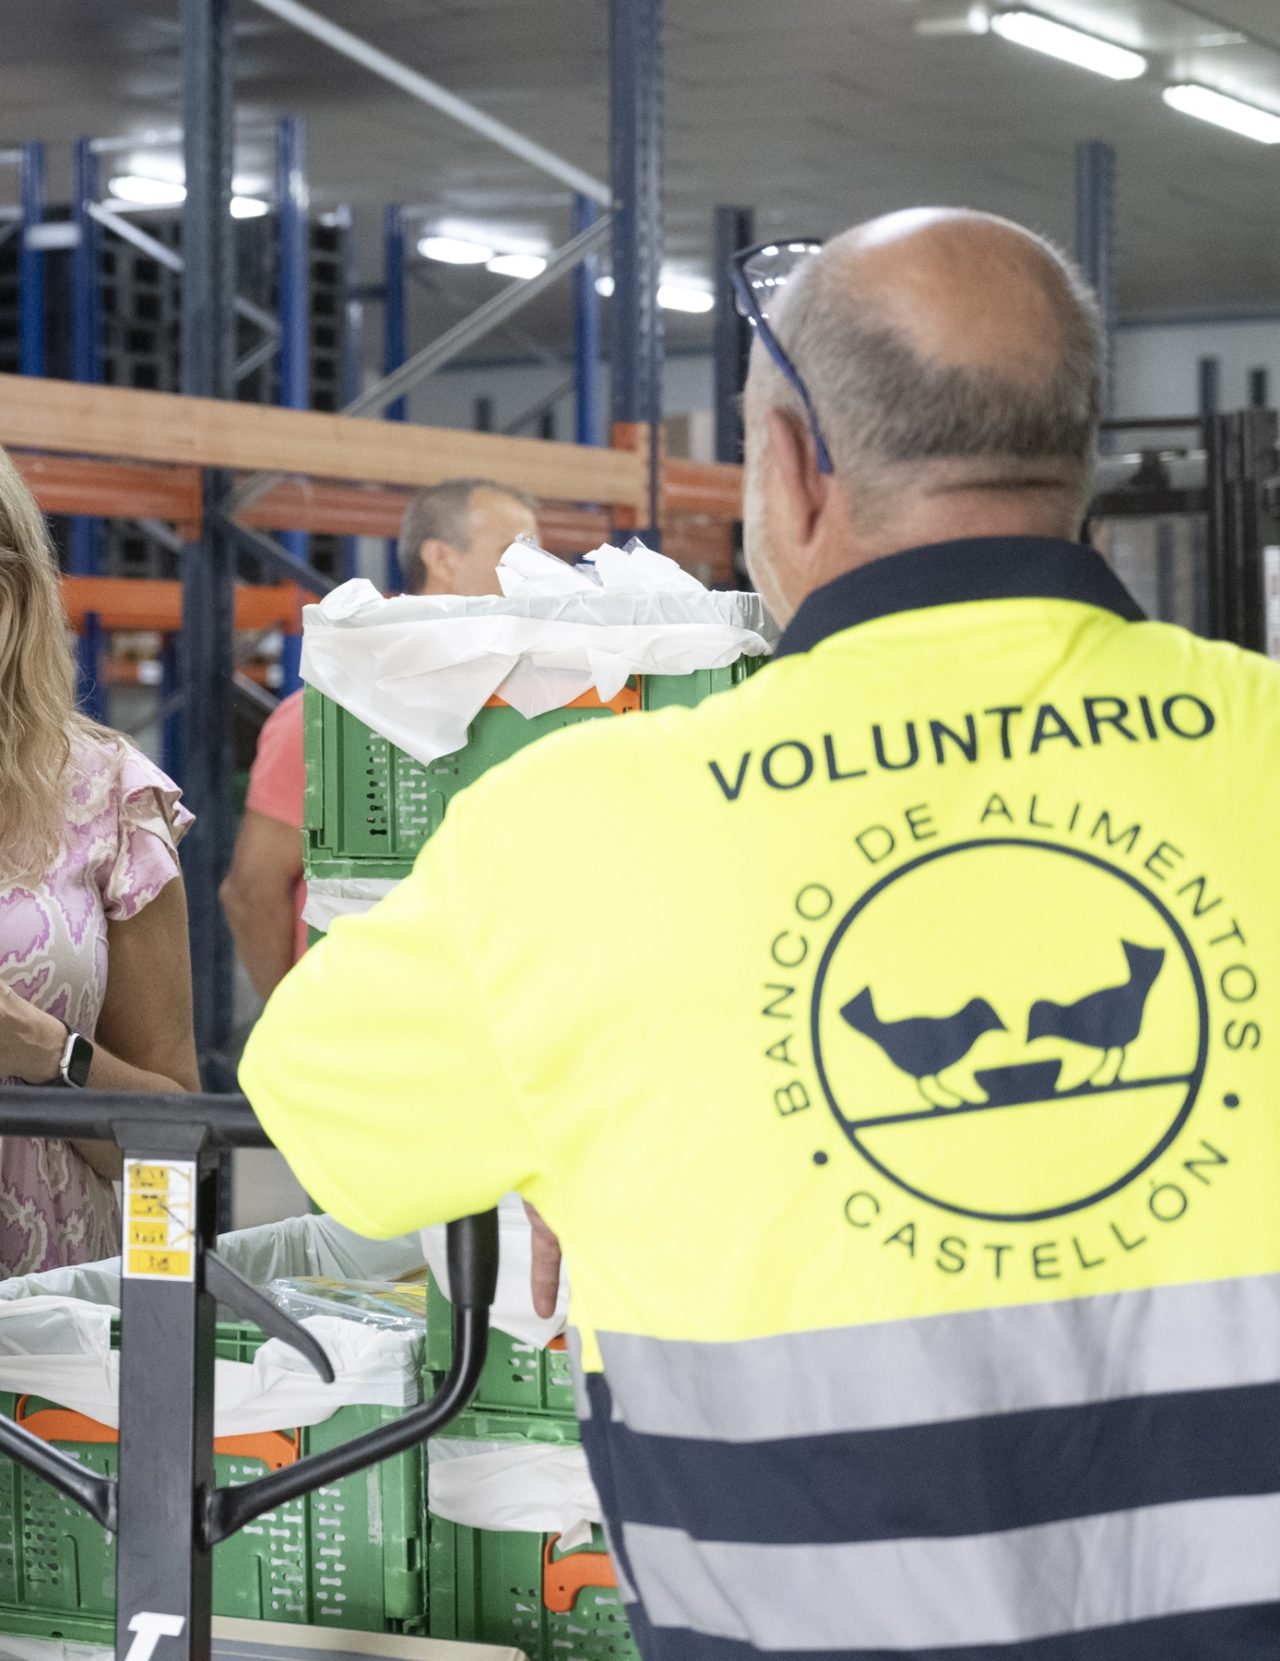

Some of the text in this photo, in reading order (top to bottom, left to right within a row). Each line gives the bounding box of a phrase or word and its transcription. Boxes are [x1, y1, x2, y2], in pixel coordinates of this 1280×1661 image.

[707, 693, 1217, 803] VOLUNTARIO
[761, 792, 1262, 1117] BANCO DE ALIMENTOS
[843, 1139, 1230, 1280] CASTELLÓN
